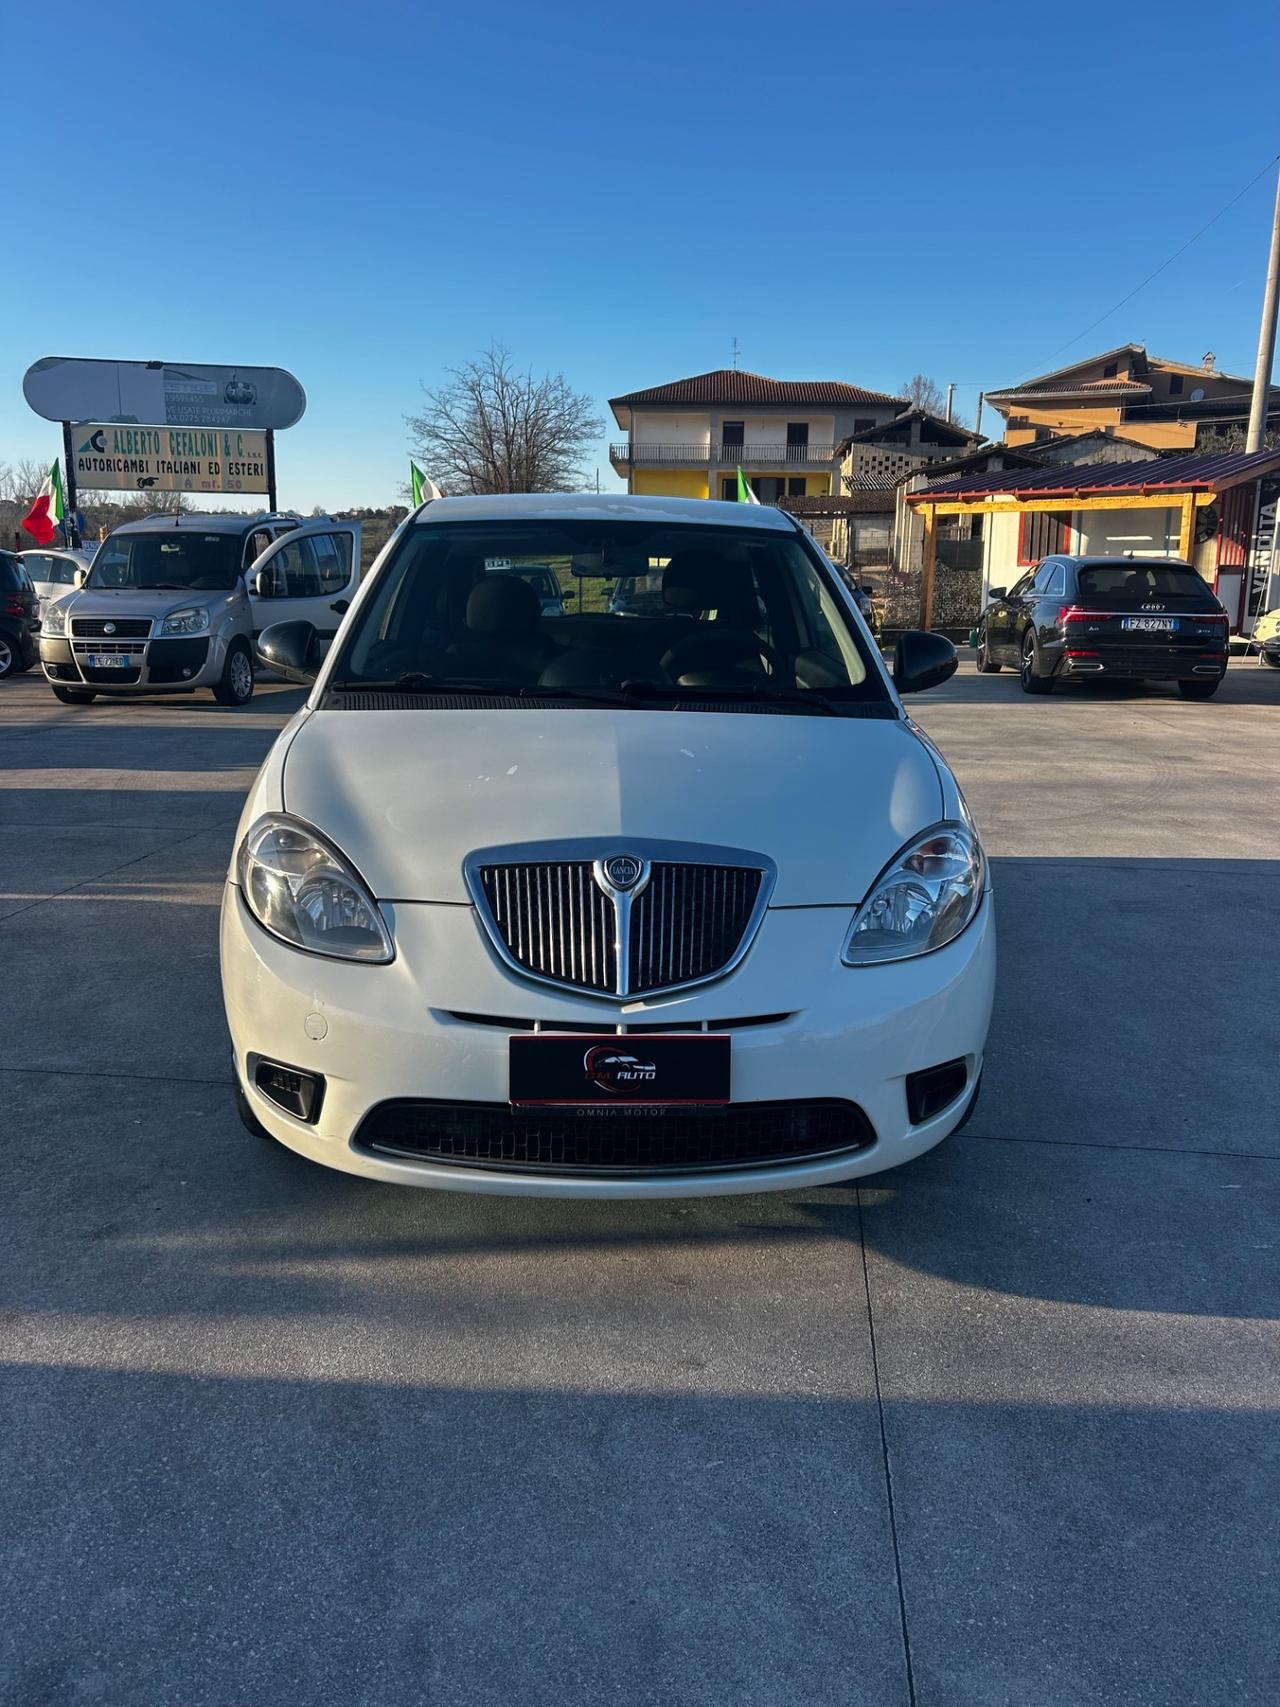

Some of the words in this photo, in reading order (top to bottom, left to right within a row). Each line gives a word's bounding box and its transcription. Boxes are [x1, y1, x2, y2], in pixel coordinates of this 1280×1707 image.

[113, 429, 160, 455] ALBERTO
[169, 431, 218, 457] CEFALONI
[224, 433, 231, 457] &
[78, 457, 149, 473] AUTORICAMBI
[157, 460, 201, 475] ITALIANI
[208, 461, 220, 475] ED
[228, 462, 264, 476] ESTERI
[227, 479, 242, 489] 50
[1252, 502, 1276, 594] VENDITA
[612, 866, 635, 875] LANCIA
[617, 1071, 656, 1080] AUTO
[576, 1108, 617, 1117] OMNIA
[624, 1108, 668, 1117] MOTOR
